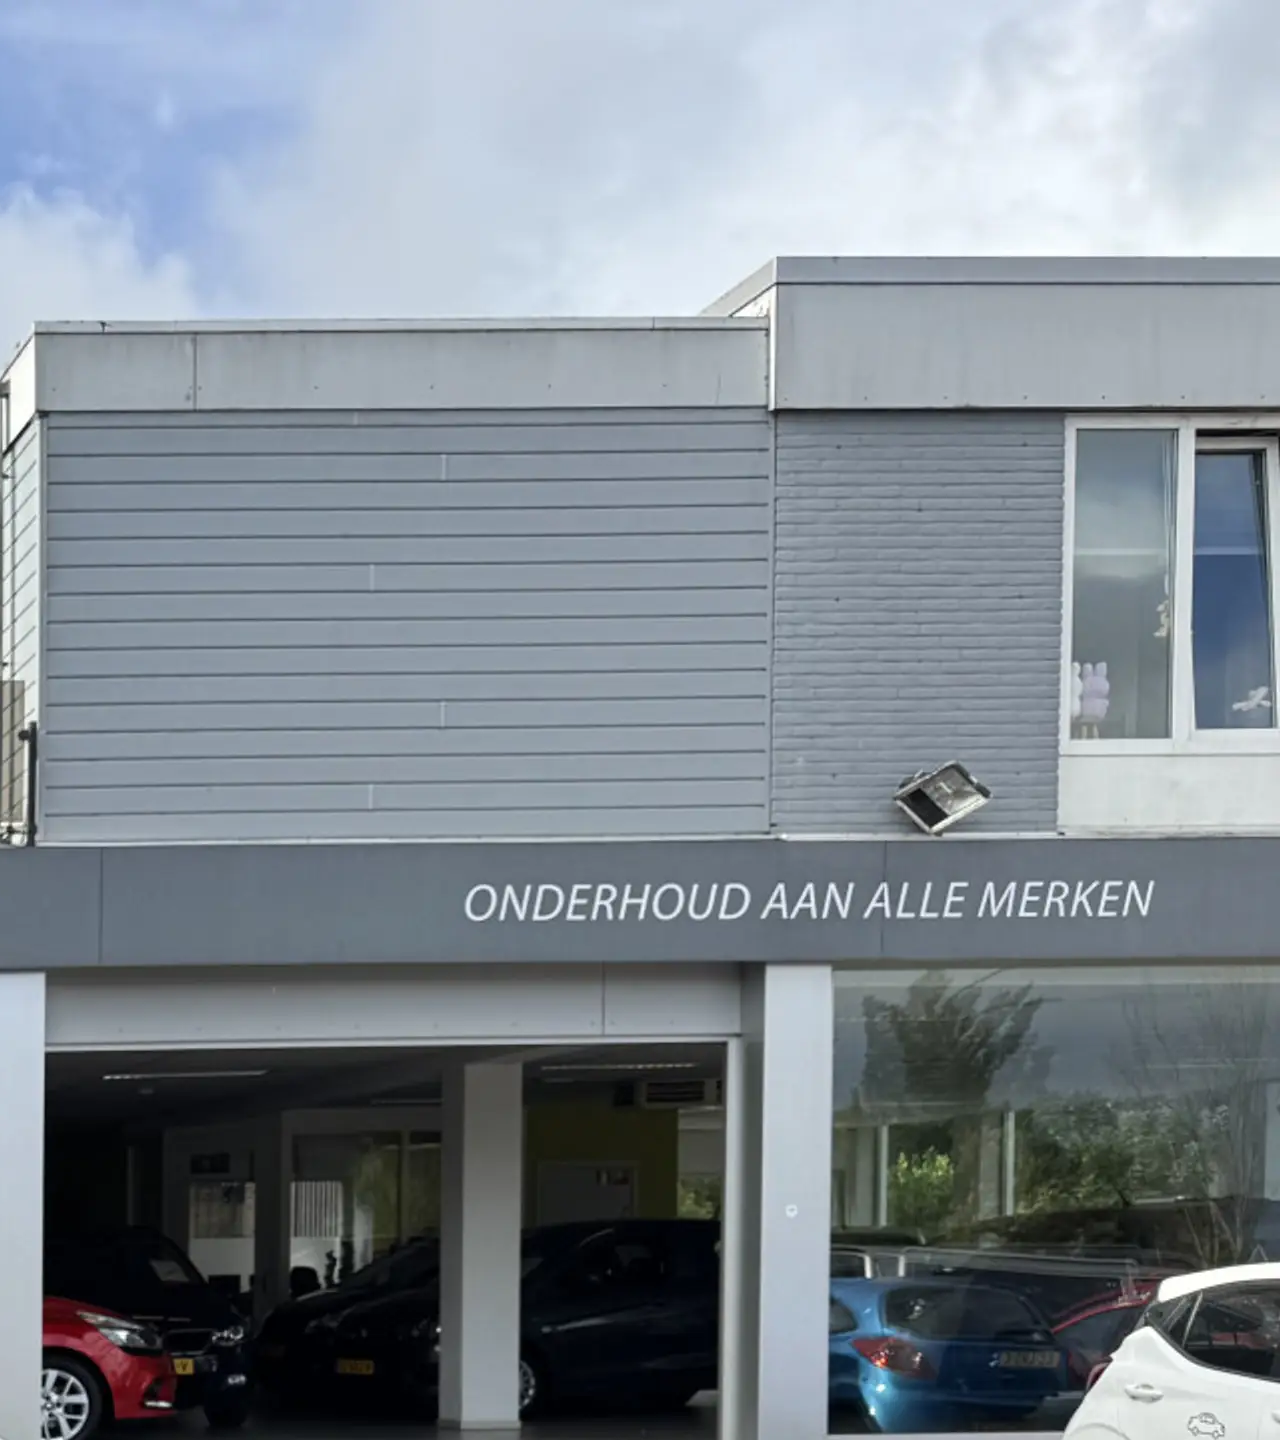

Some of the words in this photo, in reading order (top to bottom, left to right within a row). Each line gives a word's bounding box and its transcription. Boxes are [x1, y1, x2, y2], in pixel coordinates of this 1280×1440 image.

[464, 882, 751, 922] ONDERHOUD
[760, 882, 855, 920] AAN
[863, 881, 969, 919] ALLE
[977, 879, 1155, 918] MERKEN
